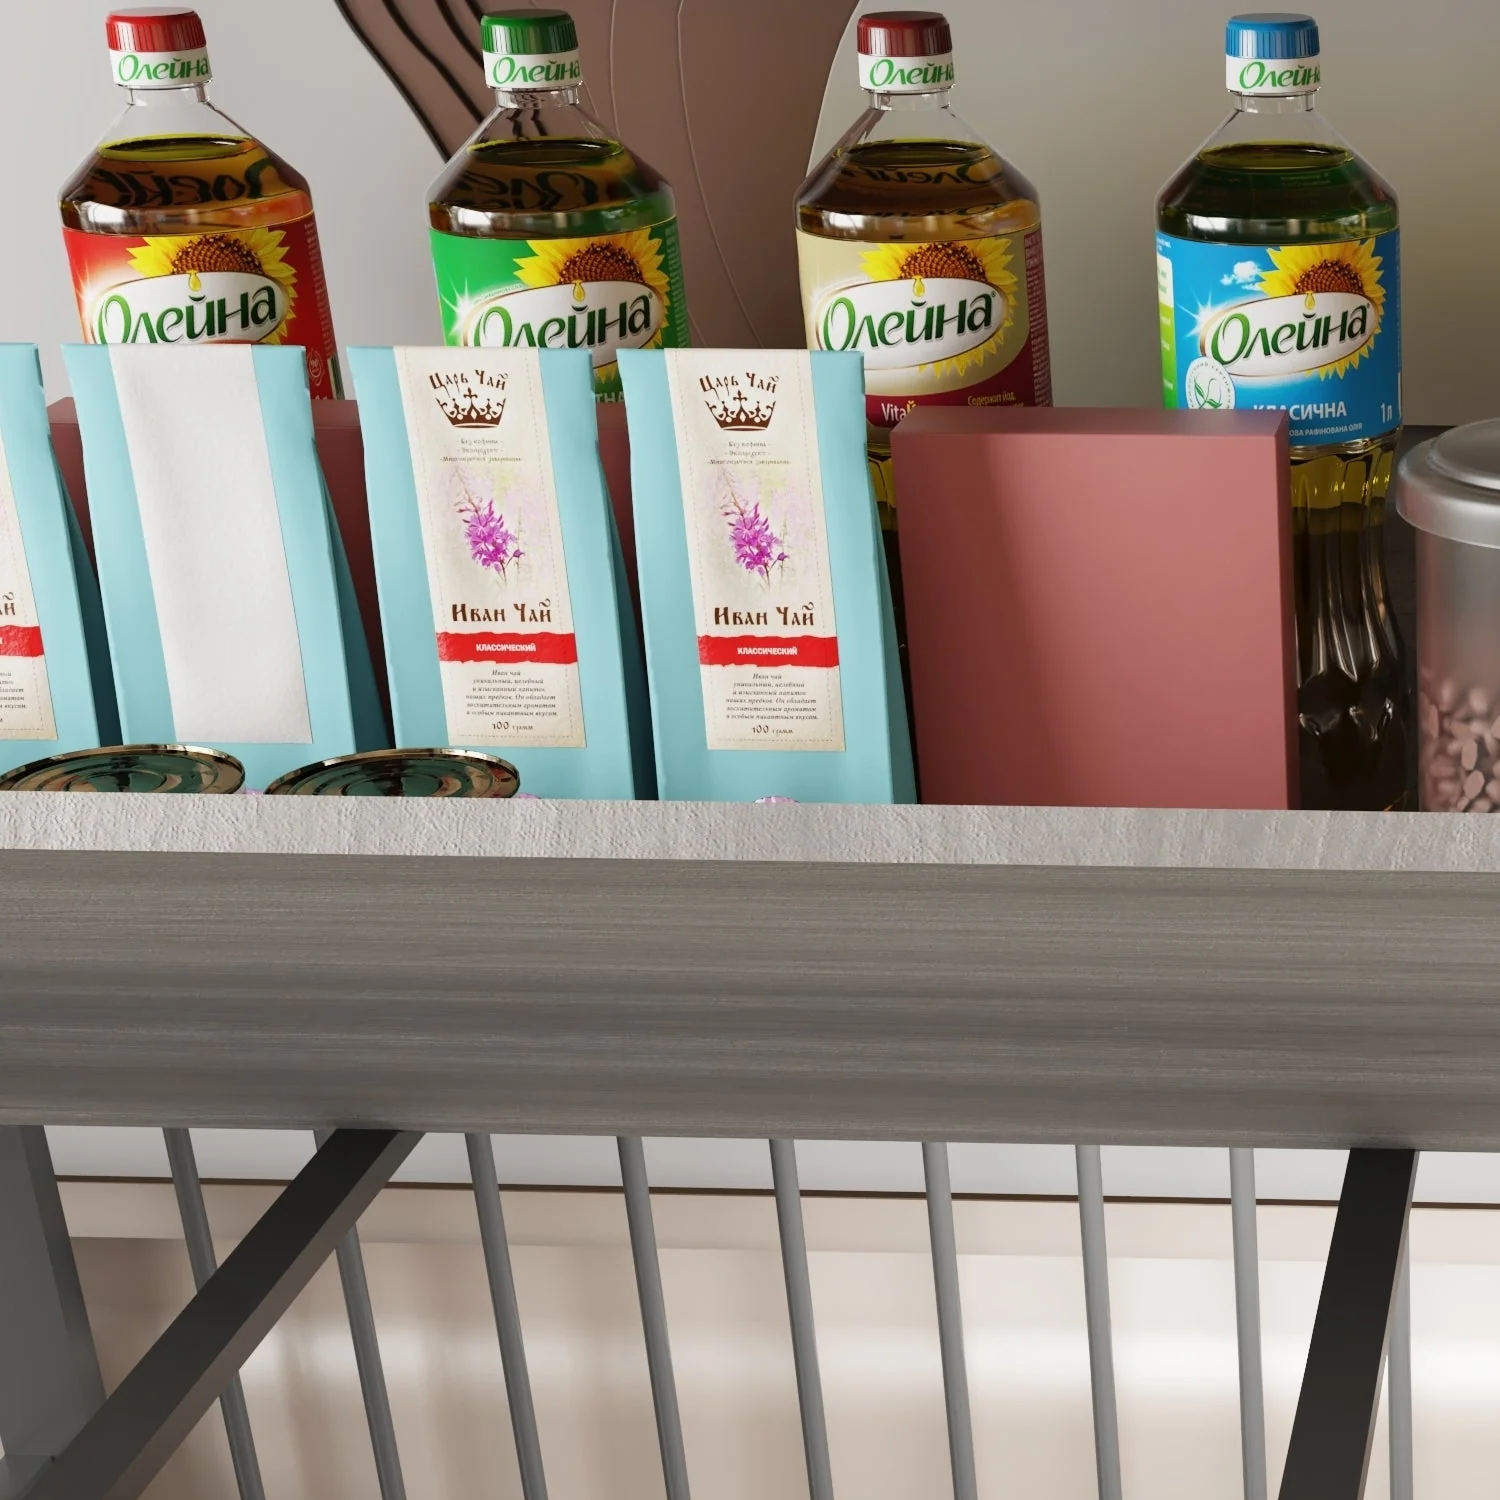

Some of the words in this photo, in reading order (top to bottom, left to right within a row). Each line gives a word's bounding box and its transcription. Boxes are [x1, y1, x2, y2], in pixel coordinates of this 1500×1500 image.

[118, 54, 209, 82] Олейна
[98, 285, 277, 344] Олейна
[473, 294, 650, 348] Олейна
[823, 292, 993, 351] Олейна
[1211, 304, 1367, 366] Олейна
[429, 372, 469, 398] Царь
[474, 369, 509, 391] Чай
[699, 375, 739, 400] Царь
[745, 372, 780, 394] Чай
[452, 603, 506, 622] Иван
[513, 598, 552, 622] Чай
[714, 606, 768, 626] Иван
[776, 601, 815, 626] Чай
[475, 642, 537, 652] КЛАССИЧЕСКИЙ
[737, 646, 798, 656] КЛАССИЧЕСКИЙ
[492, 721, 510, 730] 100
[752, 724, 769, 734] 100
